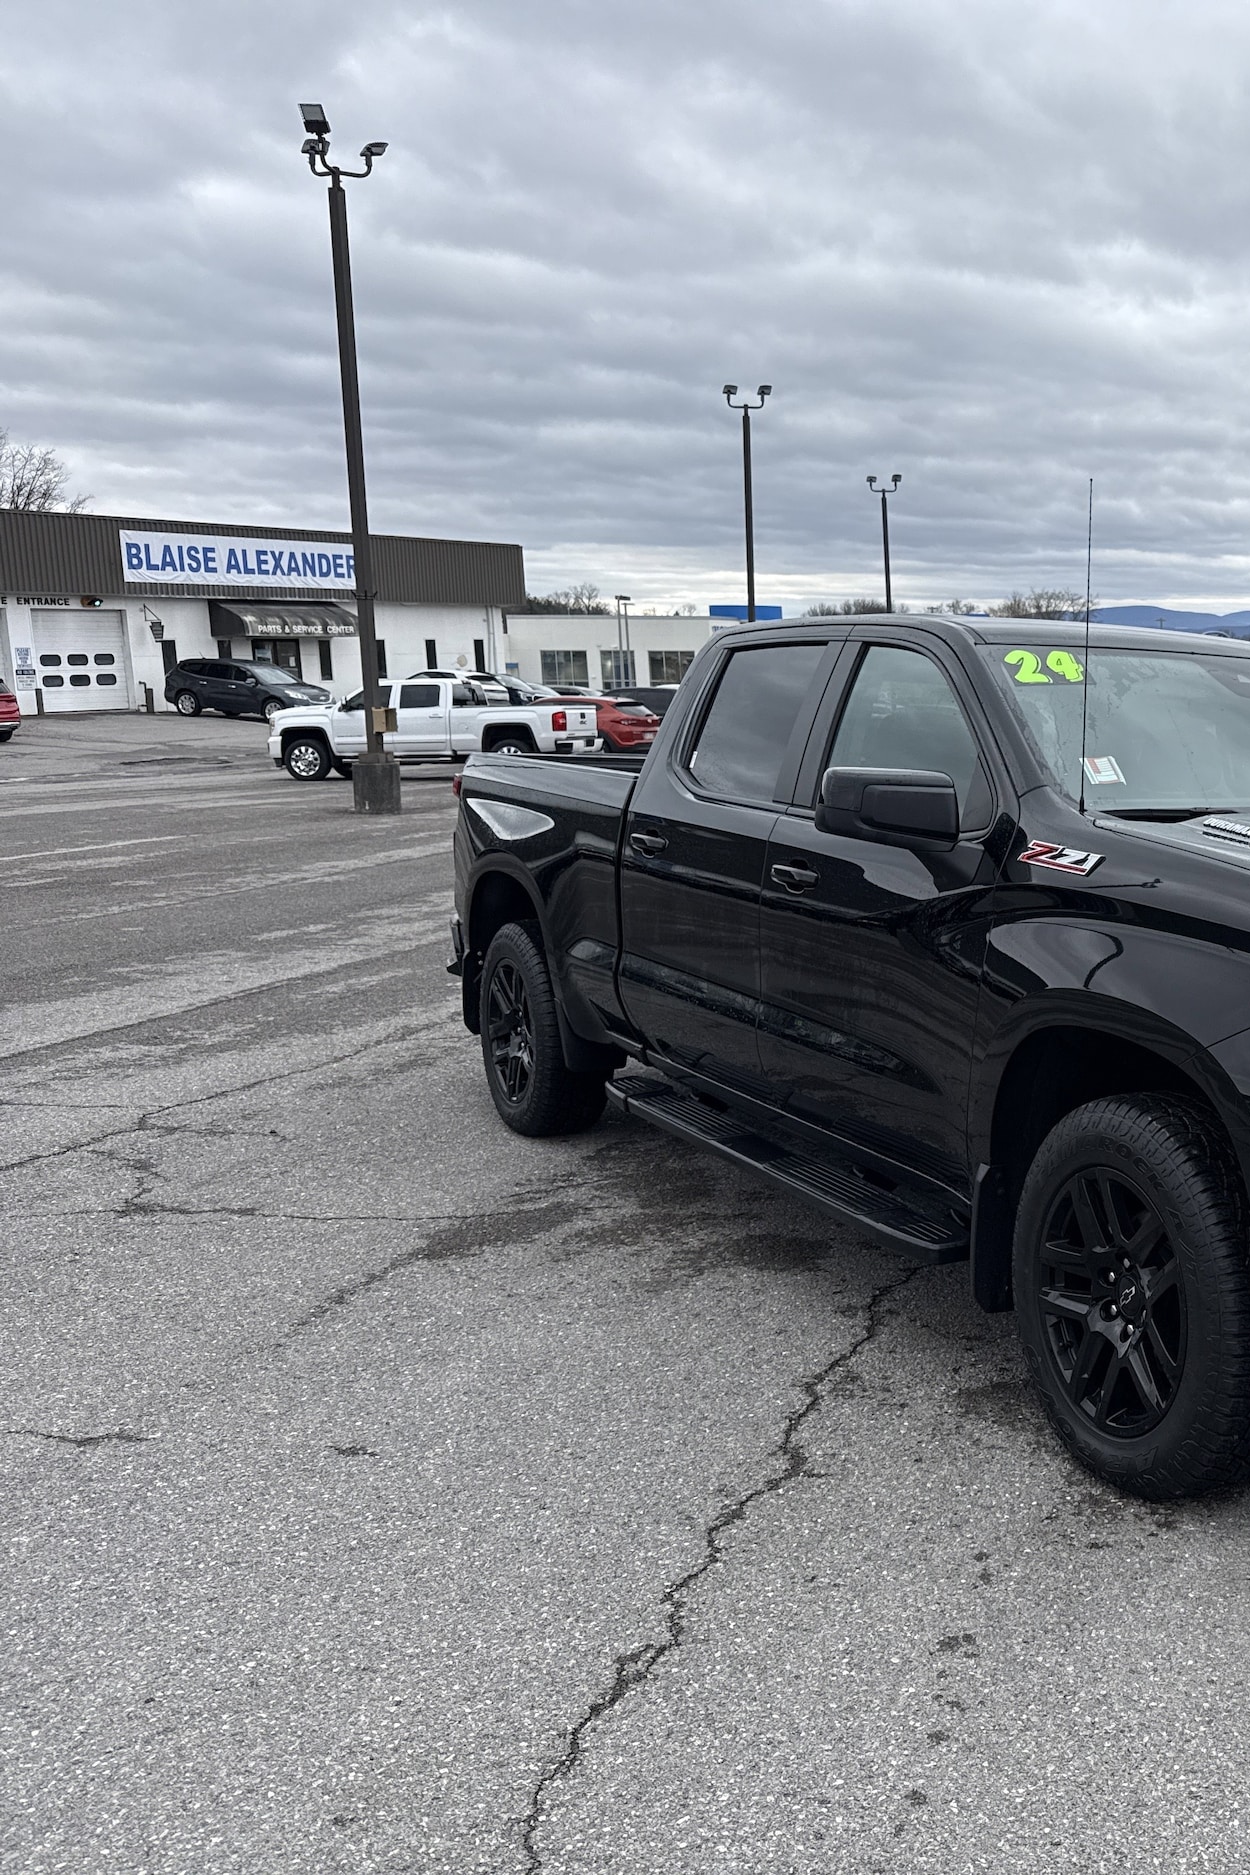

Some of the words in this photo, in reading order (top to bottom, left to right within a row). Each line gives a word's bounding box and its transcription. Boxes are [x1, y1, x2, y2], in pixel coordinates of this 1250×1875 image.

[125, 542, 218, 574] BLAISE
[225, 547, 355, 579] ALEXANDER
[16, 596, 71, 606] ENTRANCE
[258, 625, 282, 633] PARTS
[284, 625, 290, 633] &
[292, 625, 323, 634] SERVICE
[327, 625, 355, 634] CENTER
[1004, 650, 1085, 684] 24
[1017, 840, 1106, 876] Z71
